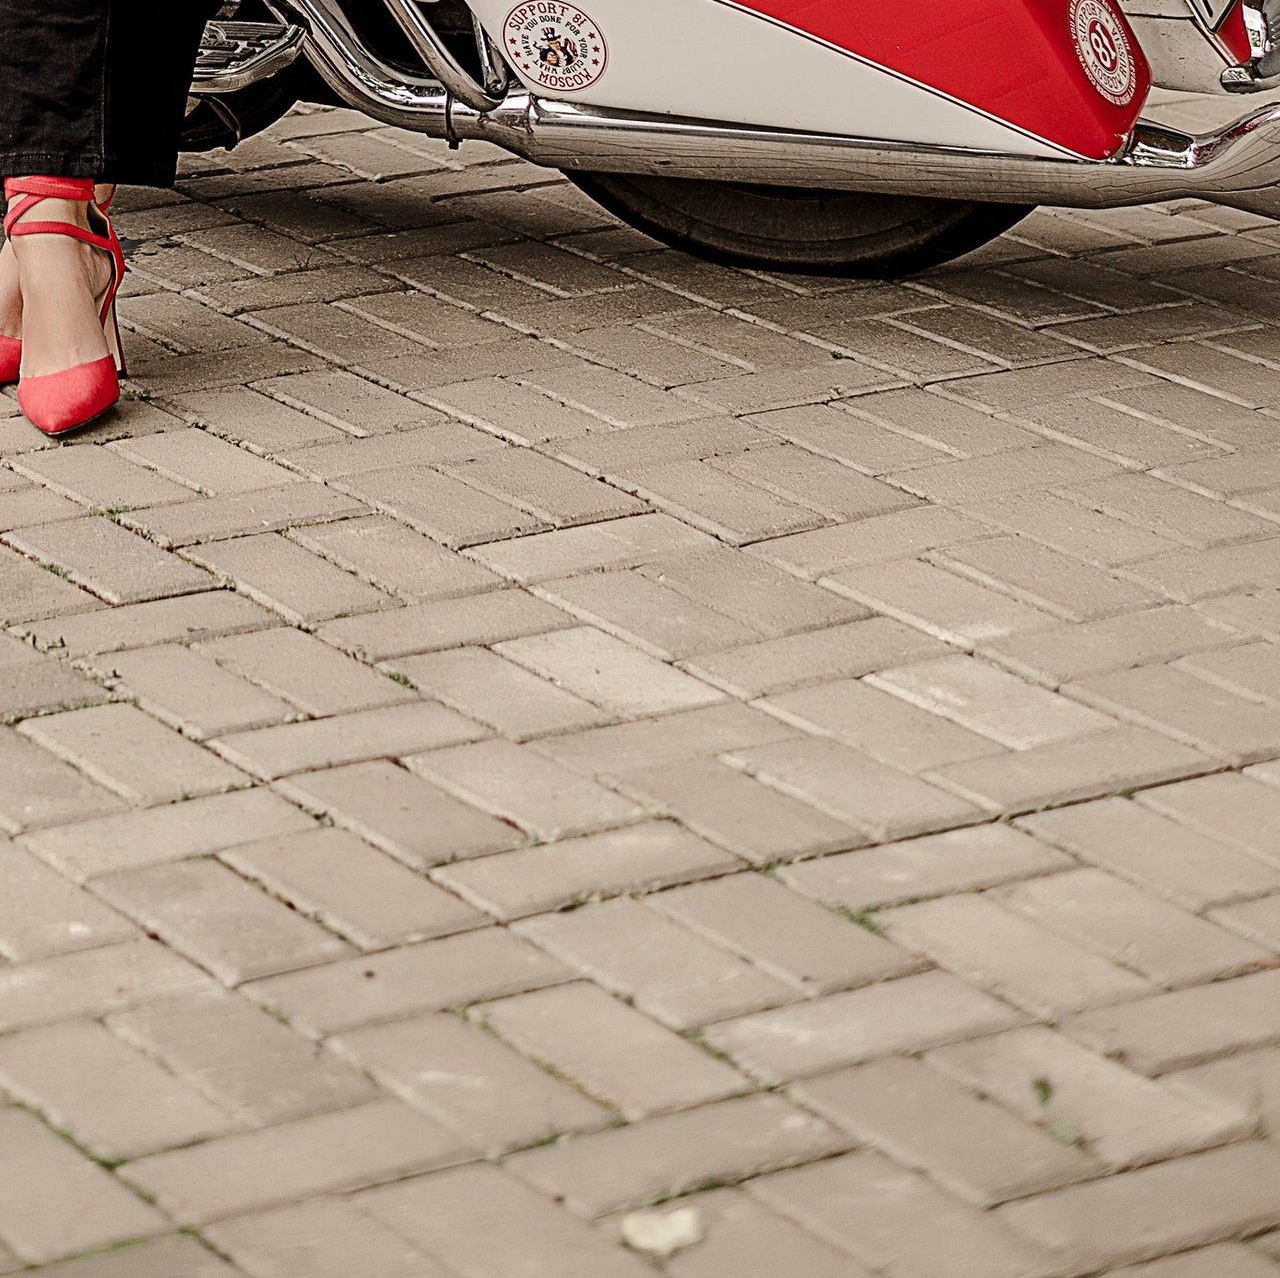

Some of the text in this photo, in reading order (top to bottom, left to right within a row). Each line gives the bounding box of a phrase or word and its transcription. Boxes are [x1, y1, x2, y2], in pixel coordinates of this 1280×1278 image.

[508, 1, 569, 31] SUPPORT
[1078, 3, 1104, 43] SUPPORT
[521, 15, 588, 75] WHAT HAVE YOU DONE FOR YOUR CLUB?
[538, 68, 593, 88] MOSCOW
[1091, 60, 1124, 89] MOSCOW
